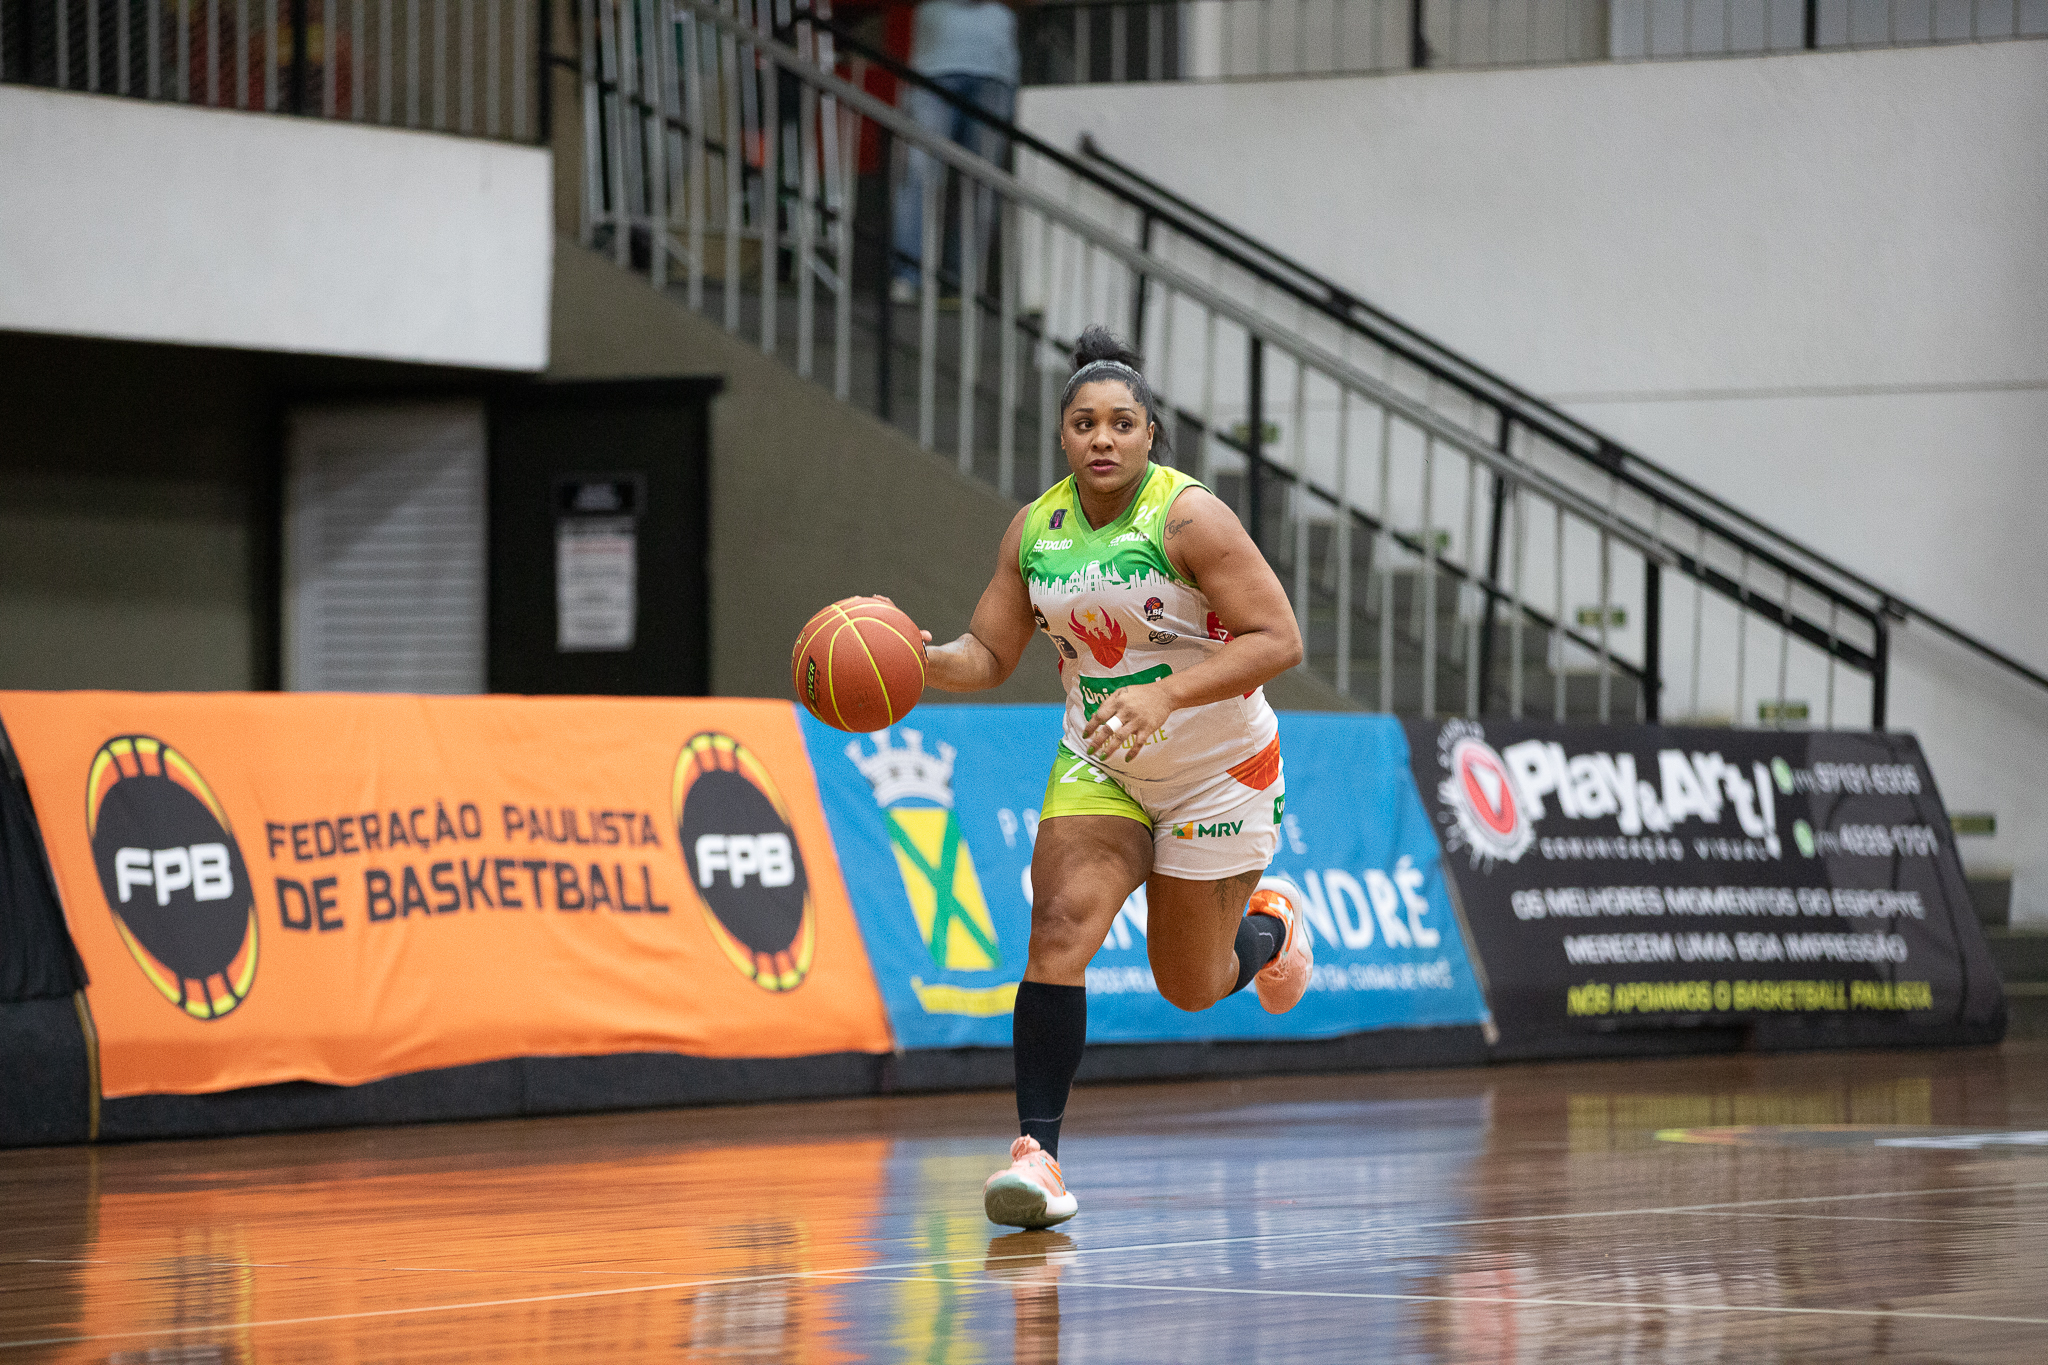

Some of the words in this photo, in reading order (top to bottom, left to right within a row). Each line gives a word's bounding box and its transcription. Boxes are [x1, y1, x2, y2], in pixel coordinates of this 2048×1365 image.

[1034, 538, 1073, 550] enxuto
[265, 801, 482, 862] FEDERAÇÃO
[503, 804, 662, 849] PAULISTA
[1198, 820, 1243, 837] MRV
[115, 843, 234, 906] FPB
[695, 832, 795, 889] FPB
[276, 876, 343, 931] DE
[364, 858, 669, 921] BASKETBALL
[1282, 855, 1441, 949] NDRÉ
[1545, 886, 1665, 916] MELHORES
[1664, 886, 1798, 916] MOMENTOS
[1831, 888, 1926, 919] ESPORTE
[1563, 932, 1675, 964] MERECEM
[1674, 932, 1737, 962] UMA
[1734, 932, 1786, 962] BOA
[1784, 931, 1908, 962] IMPRESSÃO
[1613, 981, 1713, 1012] APOIAMOS
[1713, 980, 1731, 1011] O
[1733, 980, 1847, 1011] BASKETBALL
[1850, 980, 1932, 1011] PAULISTA
